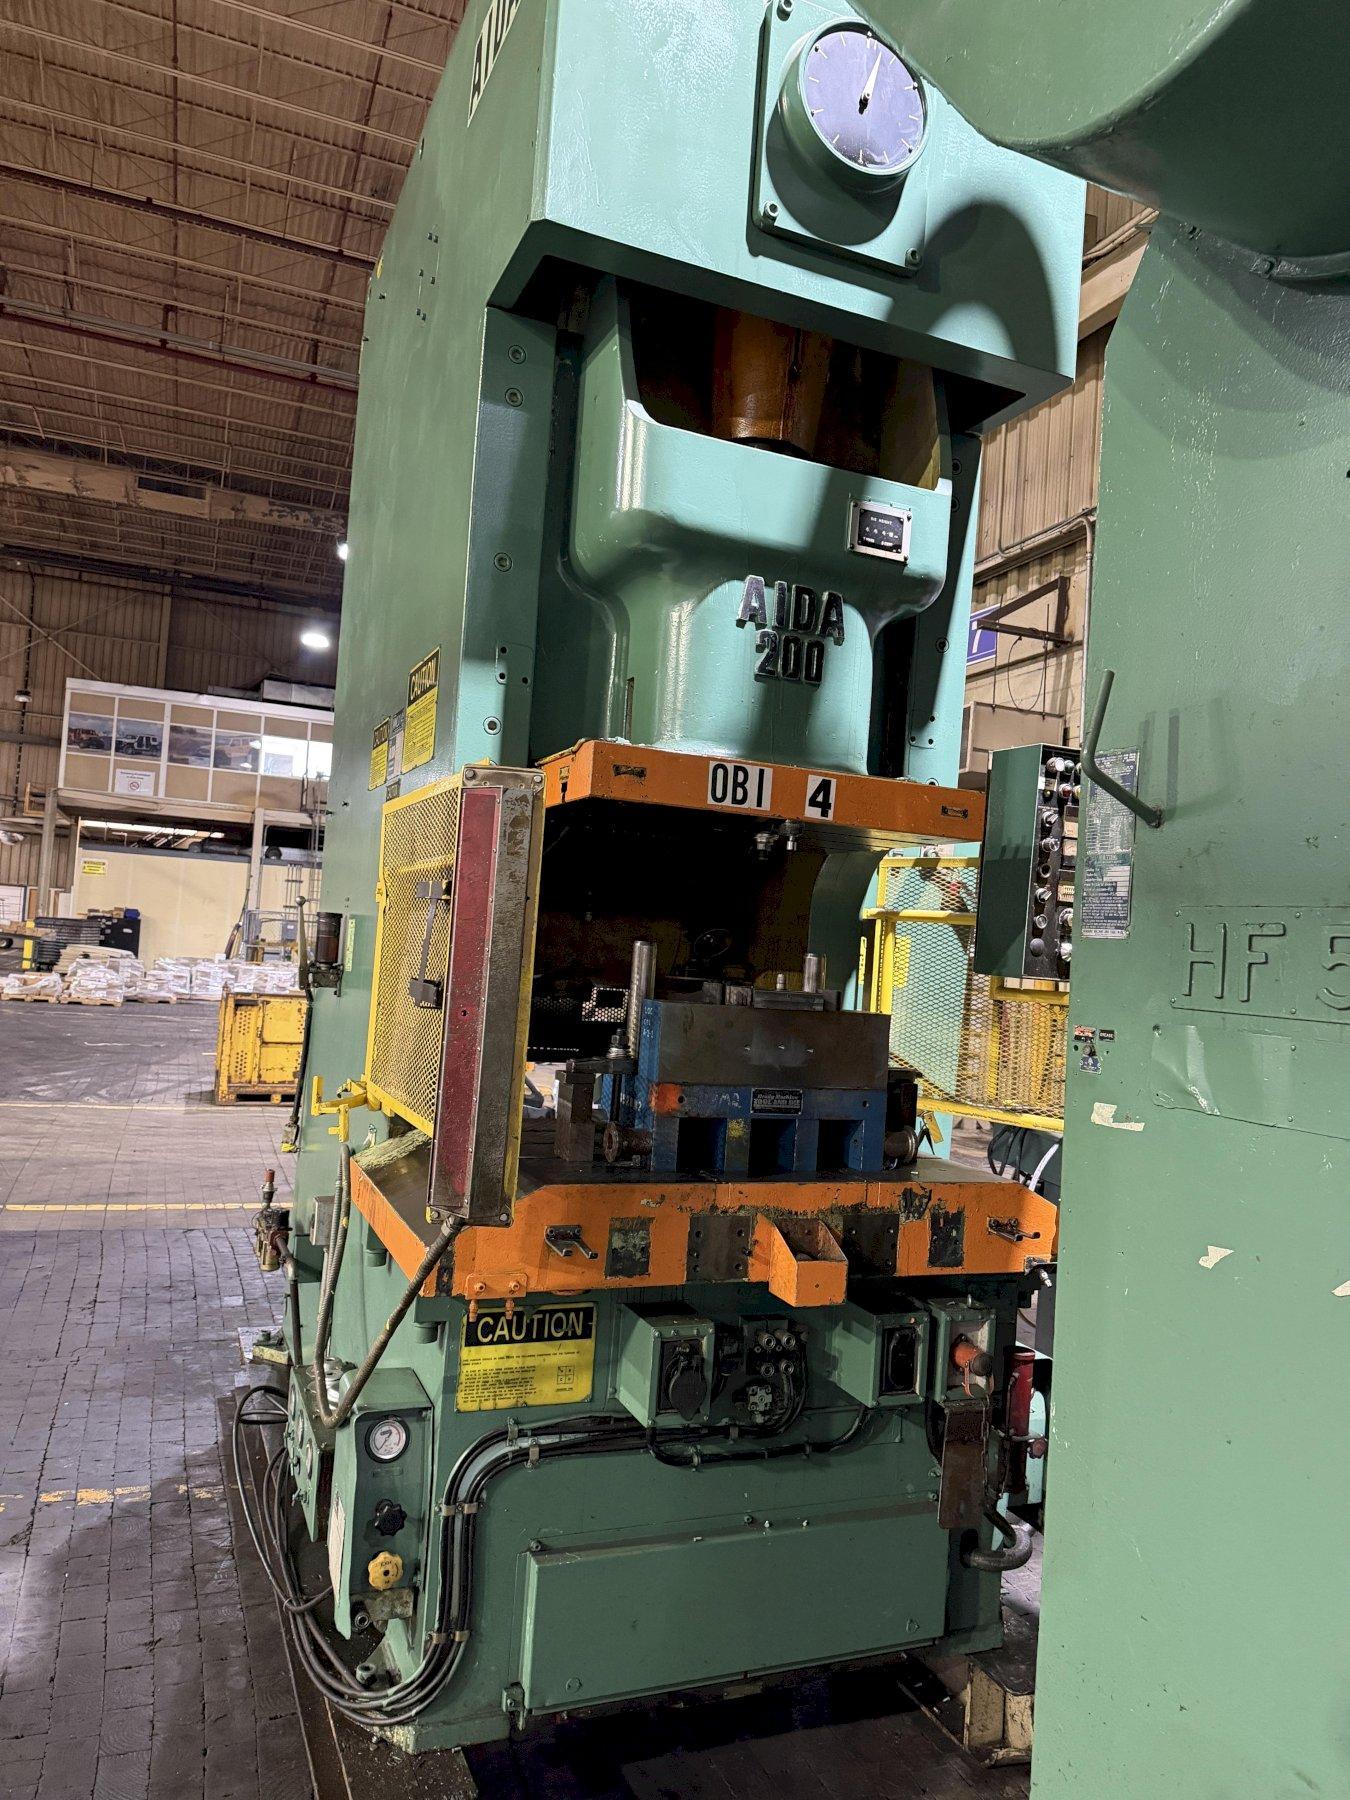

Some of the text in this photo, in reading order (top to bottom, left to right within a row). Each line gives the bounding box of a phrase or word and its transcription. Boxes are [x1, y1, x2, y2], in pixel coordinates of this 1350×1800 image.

[736, 575, 845, 645] AIDA
[410, 656, 437, 700] CAUTION
[754, 629, 825, 685] 200
[710, 763, 832, 818] OBI 4
[1181, 922, 1350, 1011] HF 5
[477, 1311, 584, 1343] CAUTION
